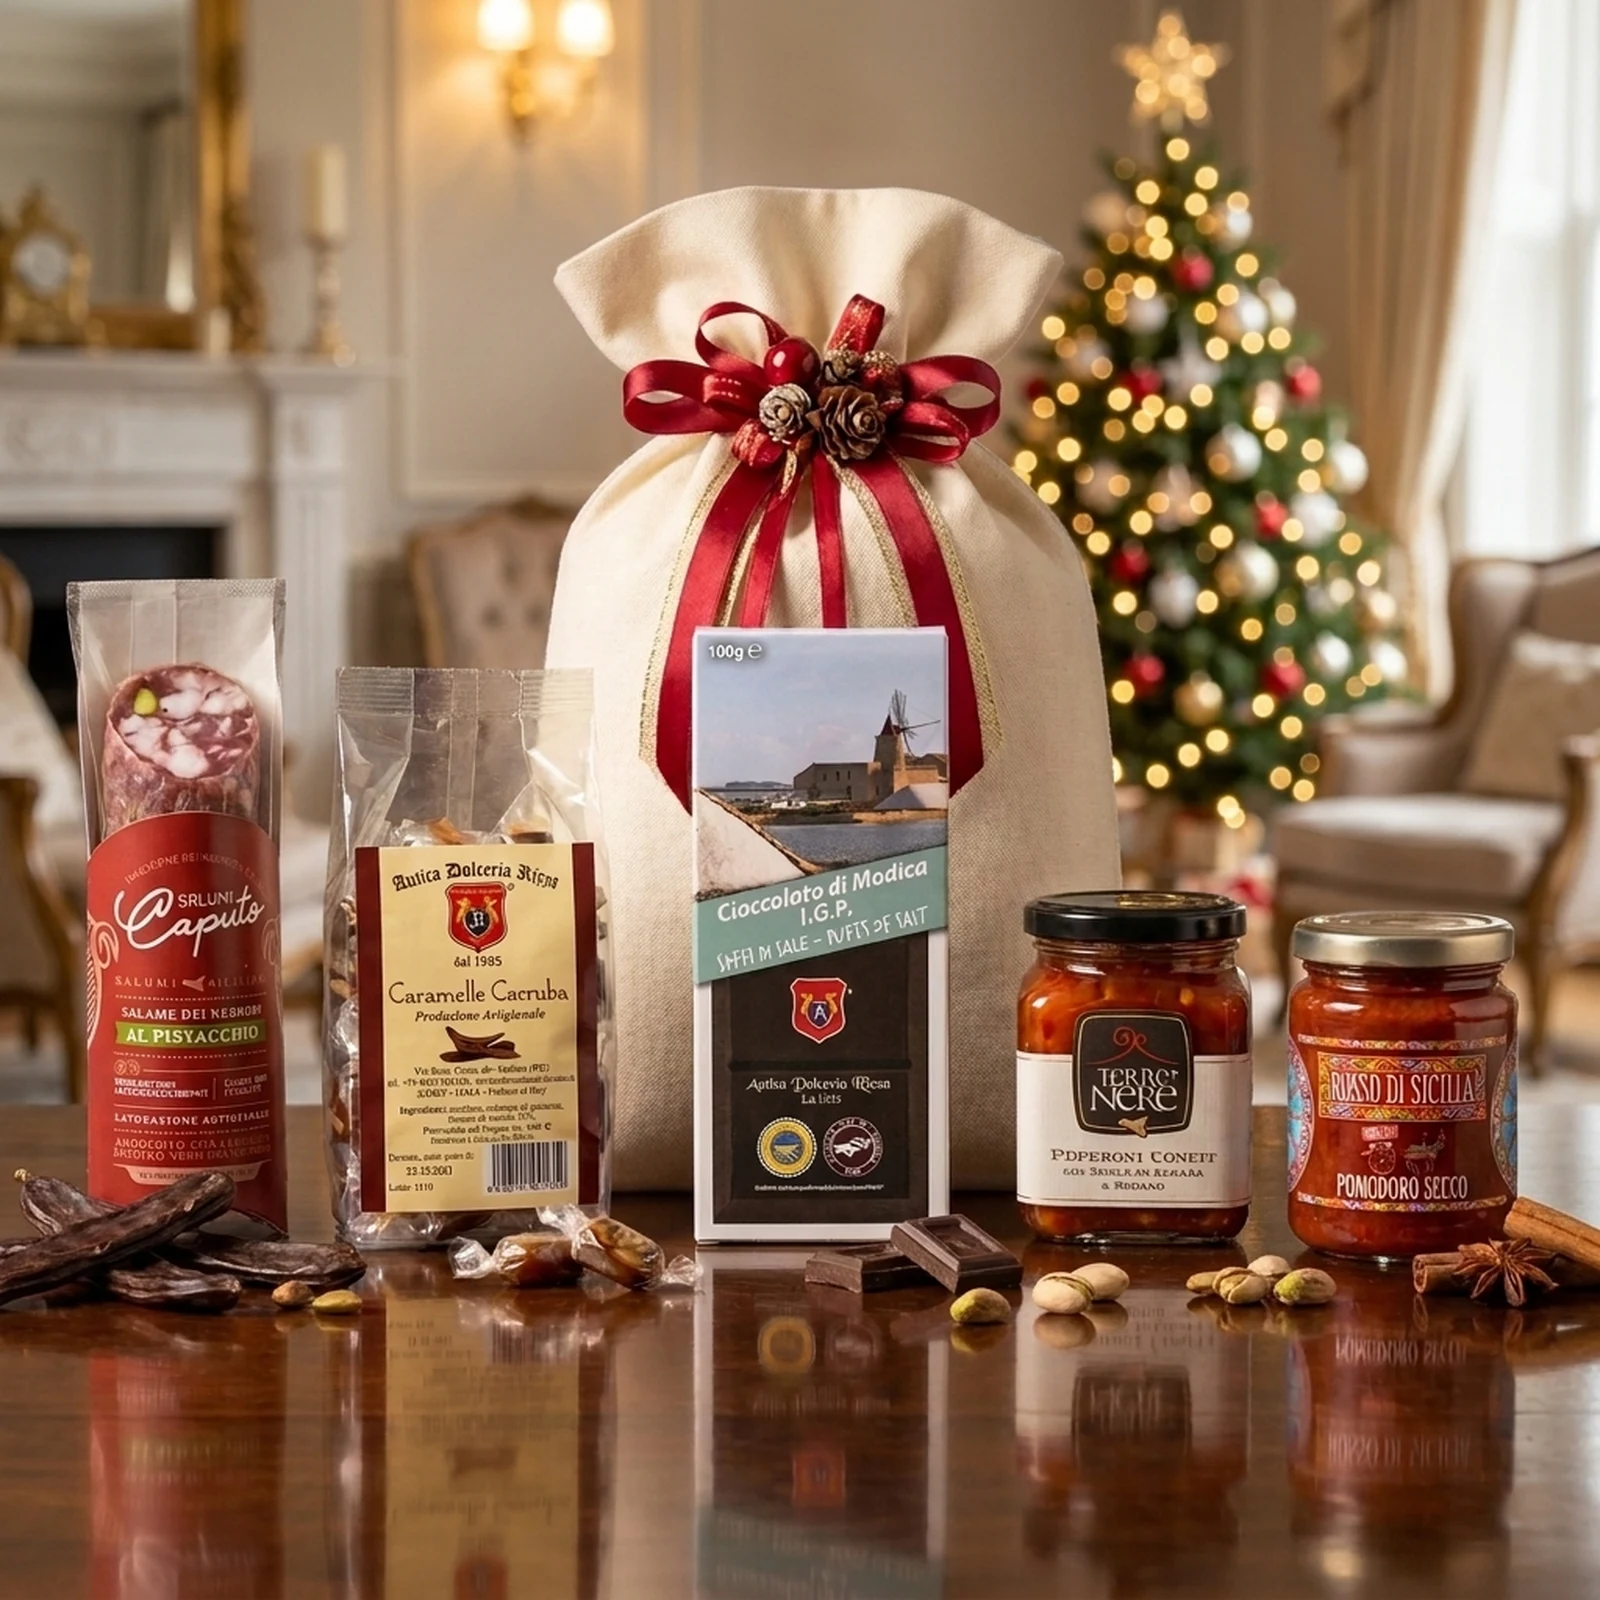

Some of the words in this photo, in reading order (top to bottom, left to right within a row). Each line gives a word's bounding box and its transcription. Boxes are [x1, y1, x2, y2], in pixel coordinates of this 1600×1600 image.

[708, 644, 744, 662] 100g
[445, 861, 512, 880] Dolceria
[828, 875, 847, 897] di
[852, 859, 928, 892] Modica
[114, 884, 266, 959] Caputo
[474, 955, 503, 968] 1985
[388, 978, 486, 1004] Caramelle
[121, 1006, 177, 1021] SALAME
[181, 1009, 207, 1021] DEI
[126, 1027, 149, 1043] AL
[1385, 1073, 1405, 1104] DI
[1336, 1172, 1420, 1200] POMODORO
[1423, 1174, 1468, 1200] SECCO
